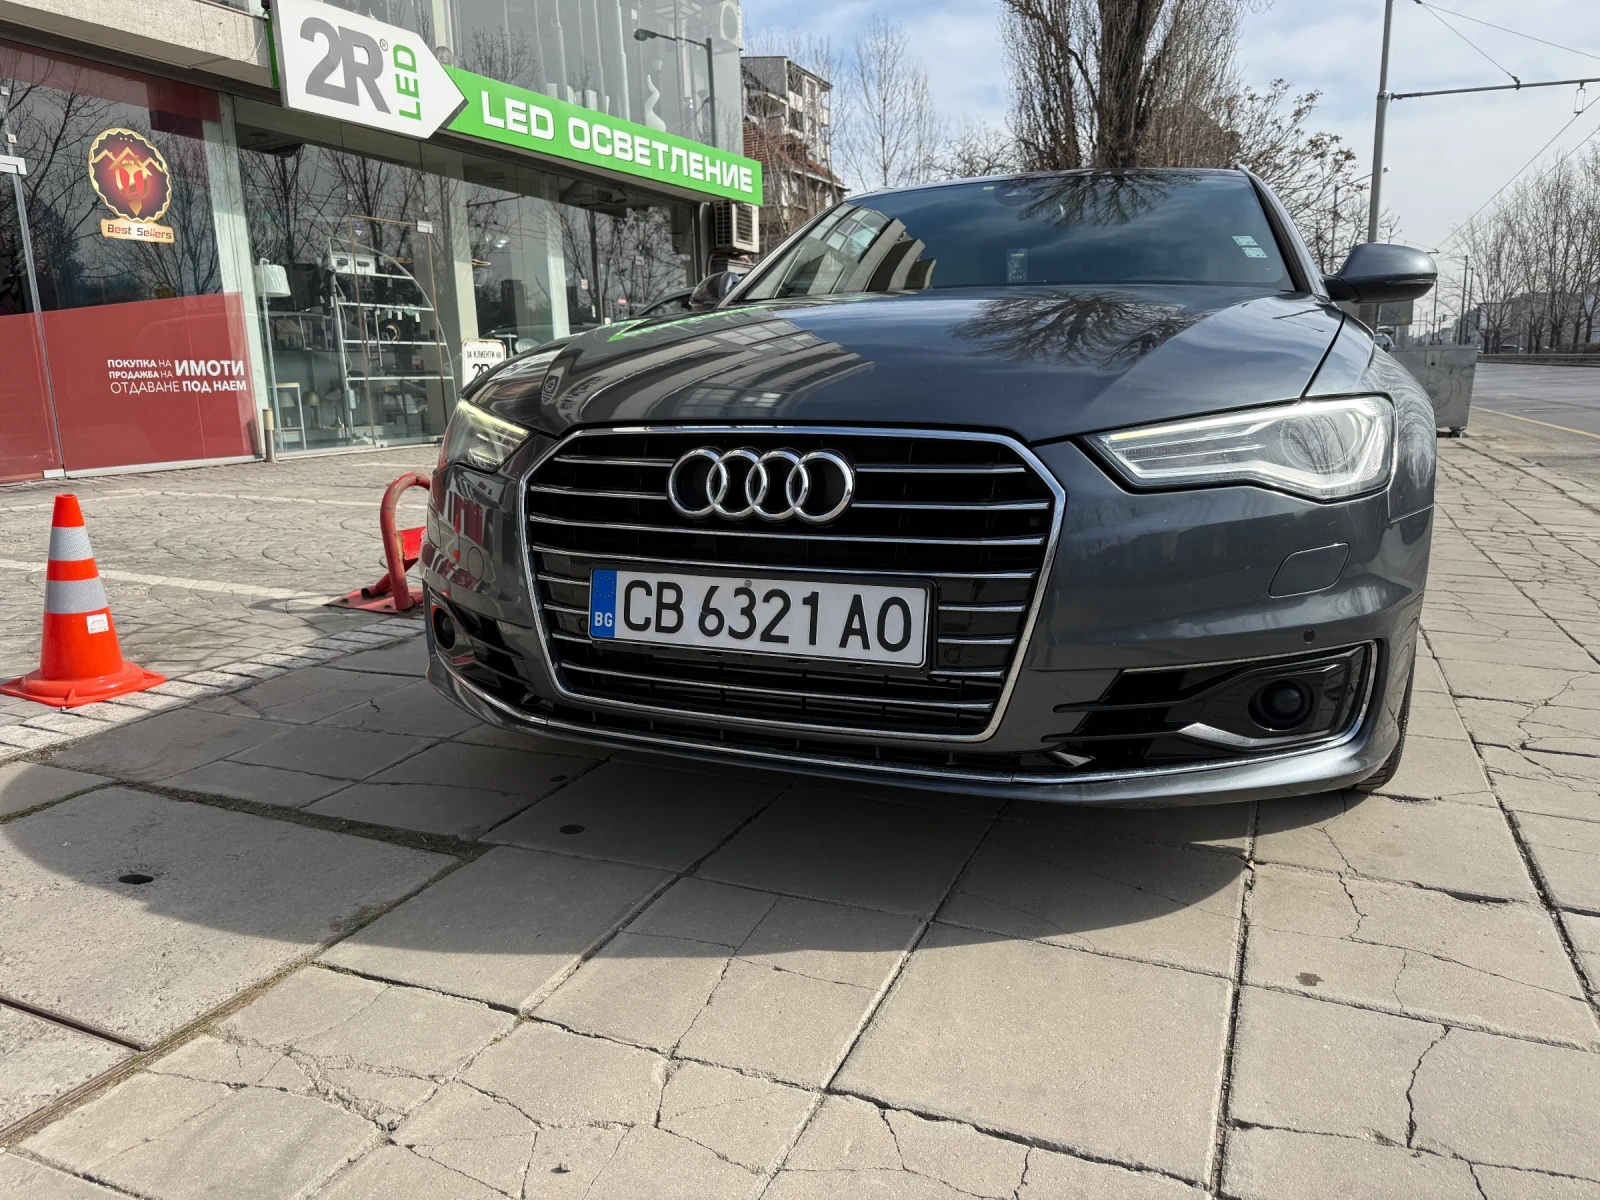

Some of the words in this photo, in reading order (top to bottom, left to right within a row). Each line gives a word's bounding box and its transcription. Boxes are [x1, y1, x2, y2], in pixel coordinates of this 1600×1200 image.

[393, 44, 422, 121] LED
[481, 91, 555, 141] LED
[568, 117, 753, 193] ОСВЕТЛЕНИЕ
[107, 224, 132, 235] Best
[136, 227, 172, 240] Sellers
[107, 359, 157, 368] ПОКУПКА
[158, 359, 172, 368] НА
[174, 360, 245, 377] ИМОТИ
[108, 370, 160, 380] ПРОДАЖБА
[160, 370, 174, 379] НА
[110, 381, 181, 395] ОТДАВАНЕ
[182, 380, 212, 393] ПОД
[212, 380, 247, 392] НАЕМ
[594, 611, 613, 627] BG
[623, 579, 684, 634] CB
[698, 585, 820, 646] 6321
[838, 593, 912, 652] AO
